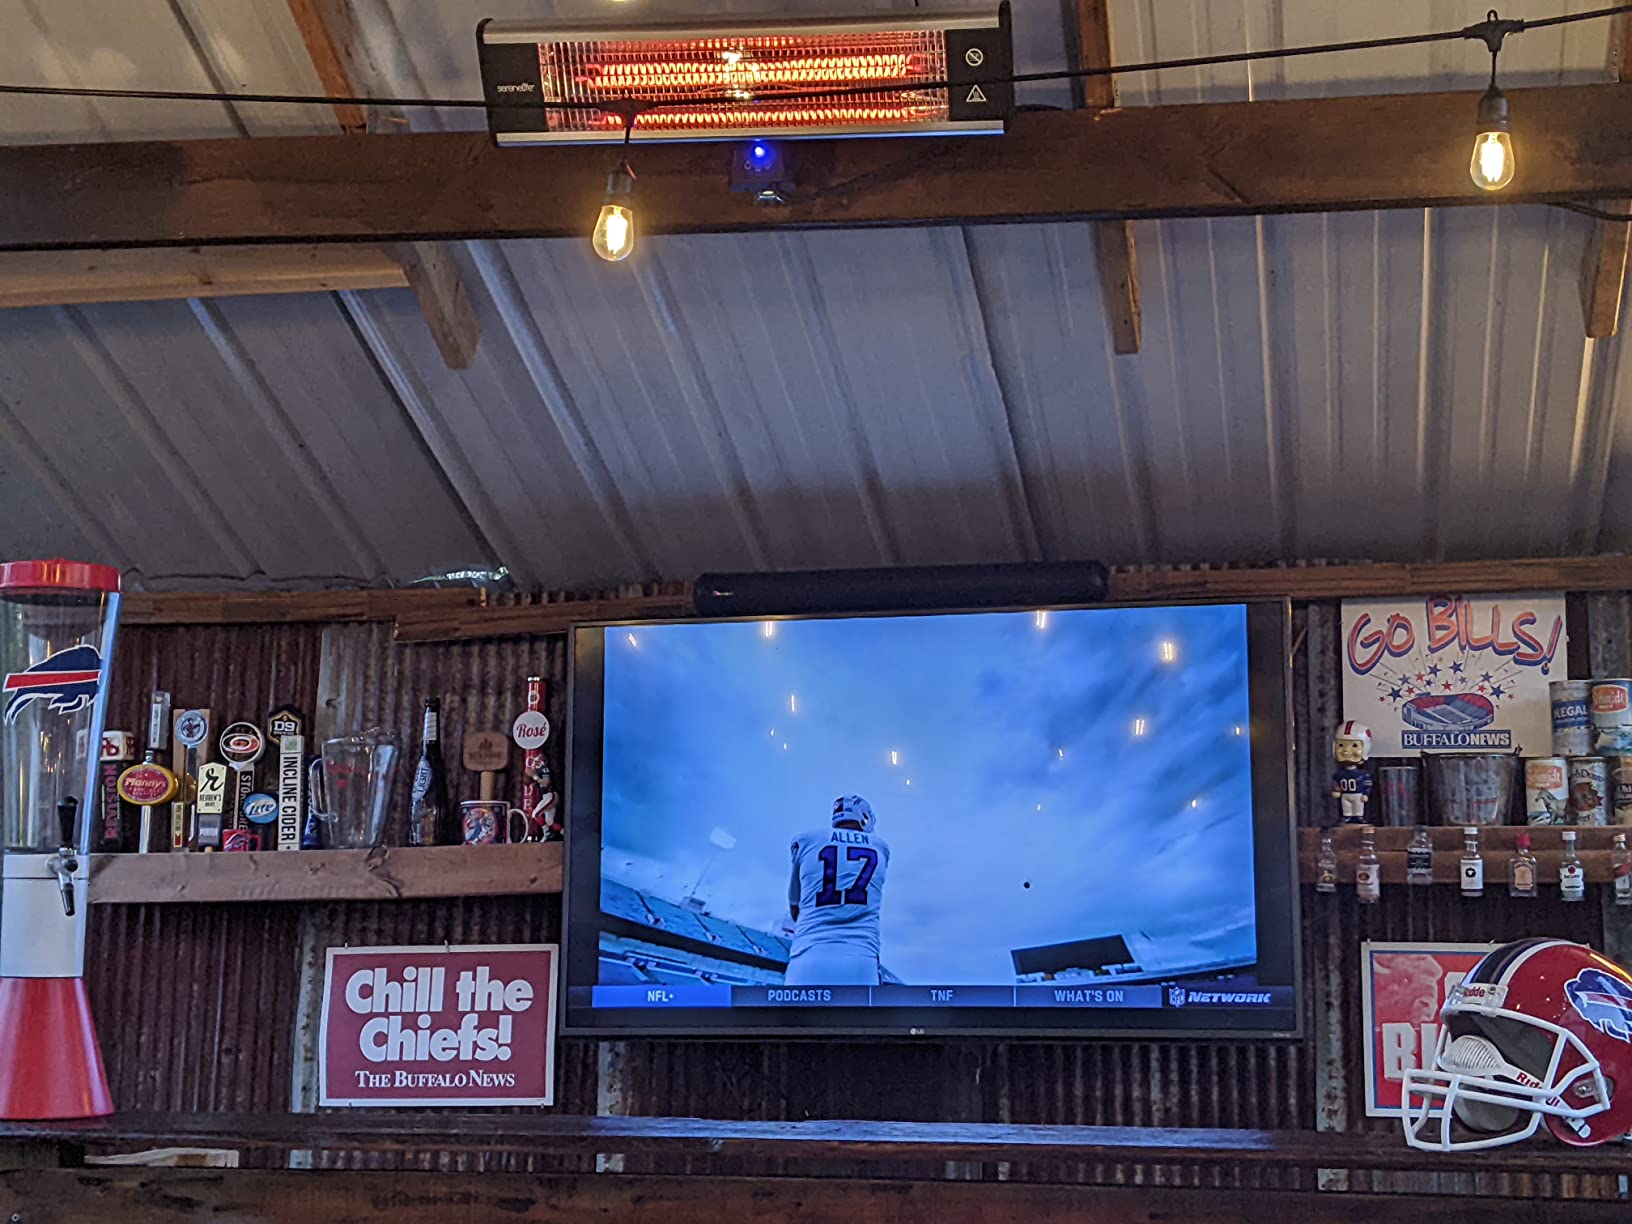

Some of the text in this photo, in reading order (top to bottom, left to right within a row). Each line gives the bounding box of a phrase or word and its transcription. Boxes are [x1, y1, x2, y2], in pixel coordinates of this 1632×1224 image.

[1348, 595, 1563, 676] GO BILLS!
[1554, 704, 1588, 719] REGAL
[274, 720, 296, 732] D9
[516, 722, 547, 739] Rosé
[1403, 732, 1511, 747] BUFFALO NEWS
[124, 777, 166, 790] Manny's
[1340, 778, 1357, 792] 00
[104, 763, 118, 839] REVISION
[281, 756, 299, 841] INCLINE CIDER
[830, 831, 869, 844] ALLEN
[815, 845, 879, 907] 17
[345, 966, 534, 1014] Chill the
[647, 990, 675, 1002] NFL+
[767, 989, 832, 1002] PODCASTS
[930, 989, 953, 1002] TNF
[1053, 989, 1104, 1002] WHAT'S
[1106, 989, 1124, 1002] ON
[1187, 991, 1272, 1003] NETWORK
[359, 1013, 513, 1063] Chiefs!
[355, 1069, 515, 1088] THE BUFFALO NEWS
